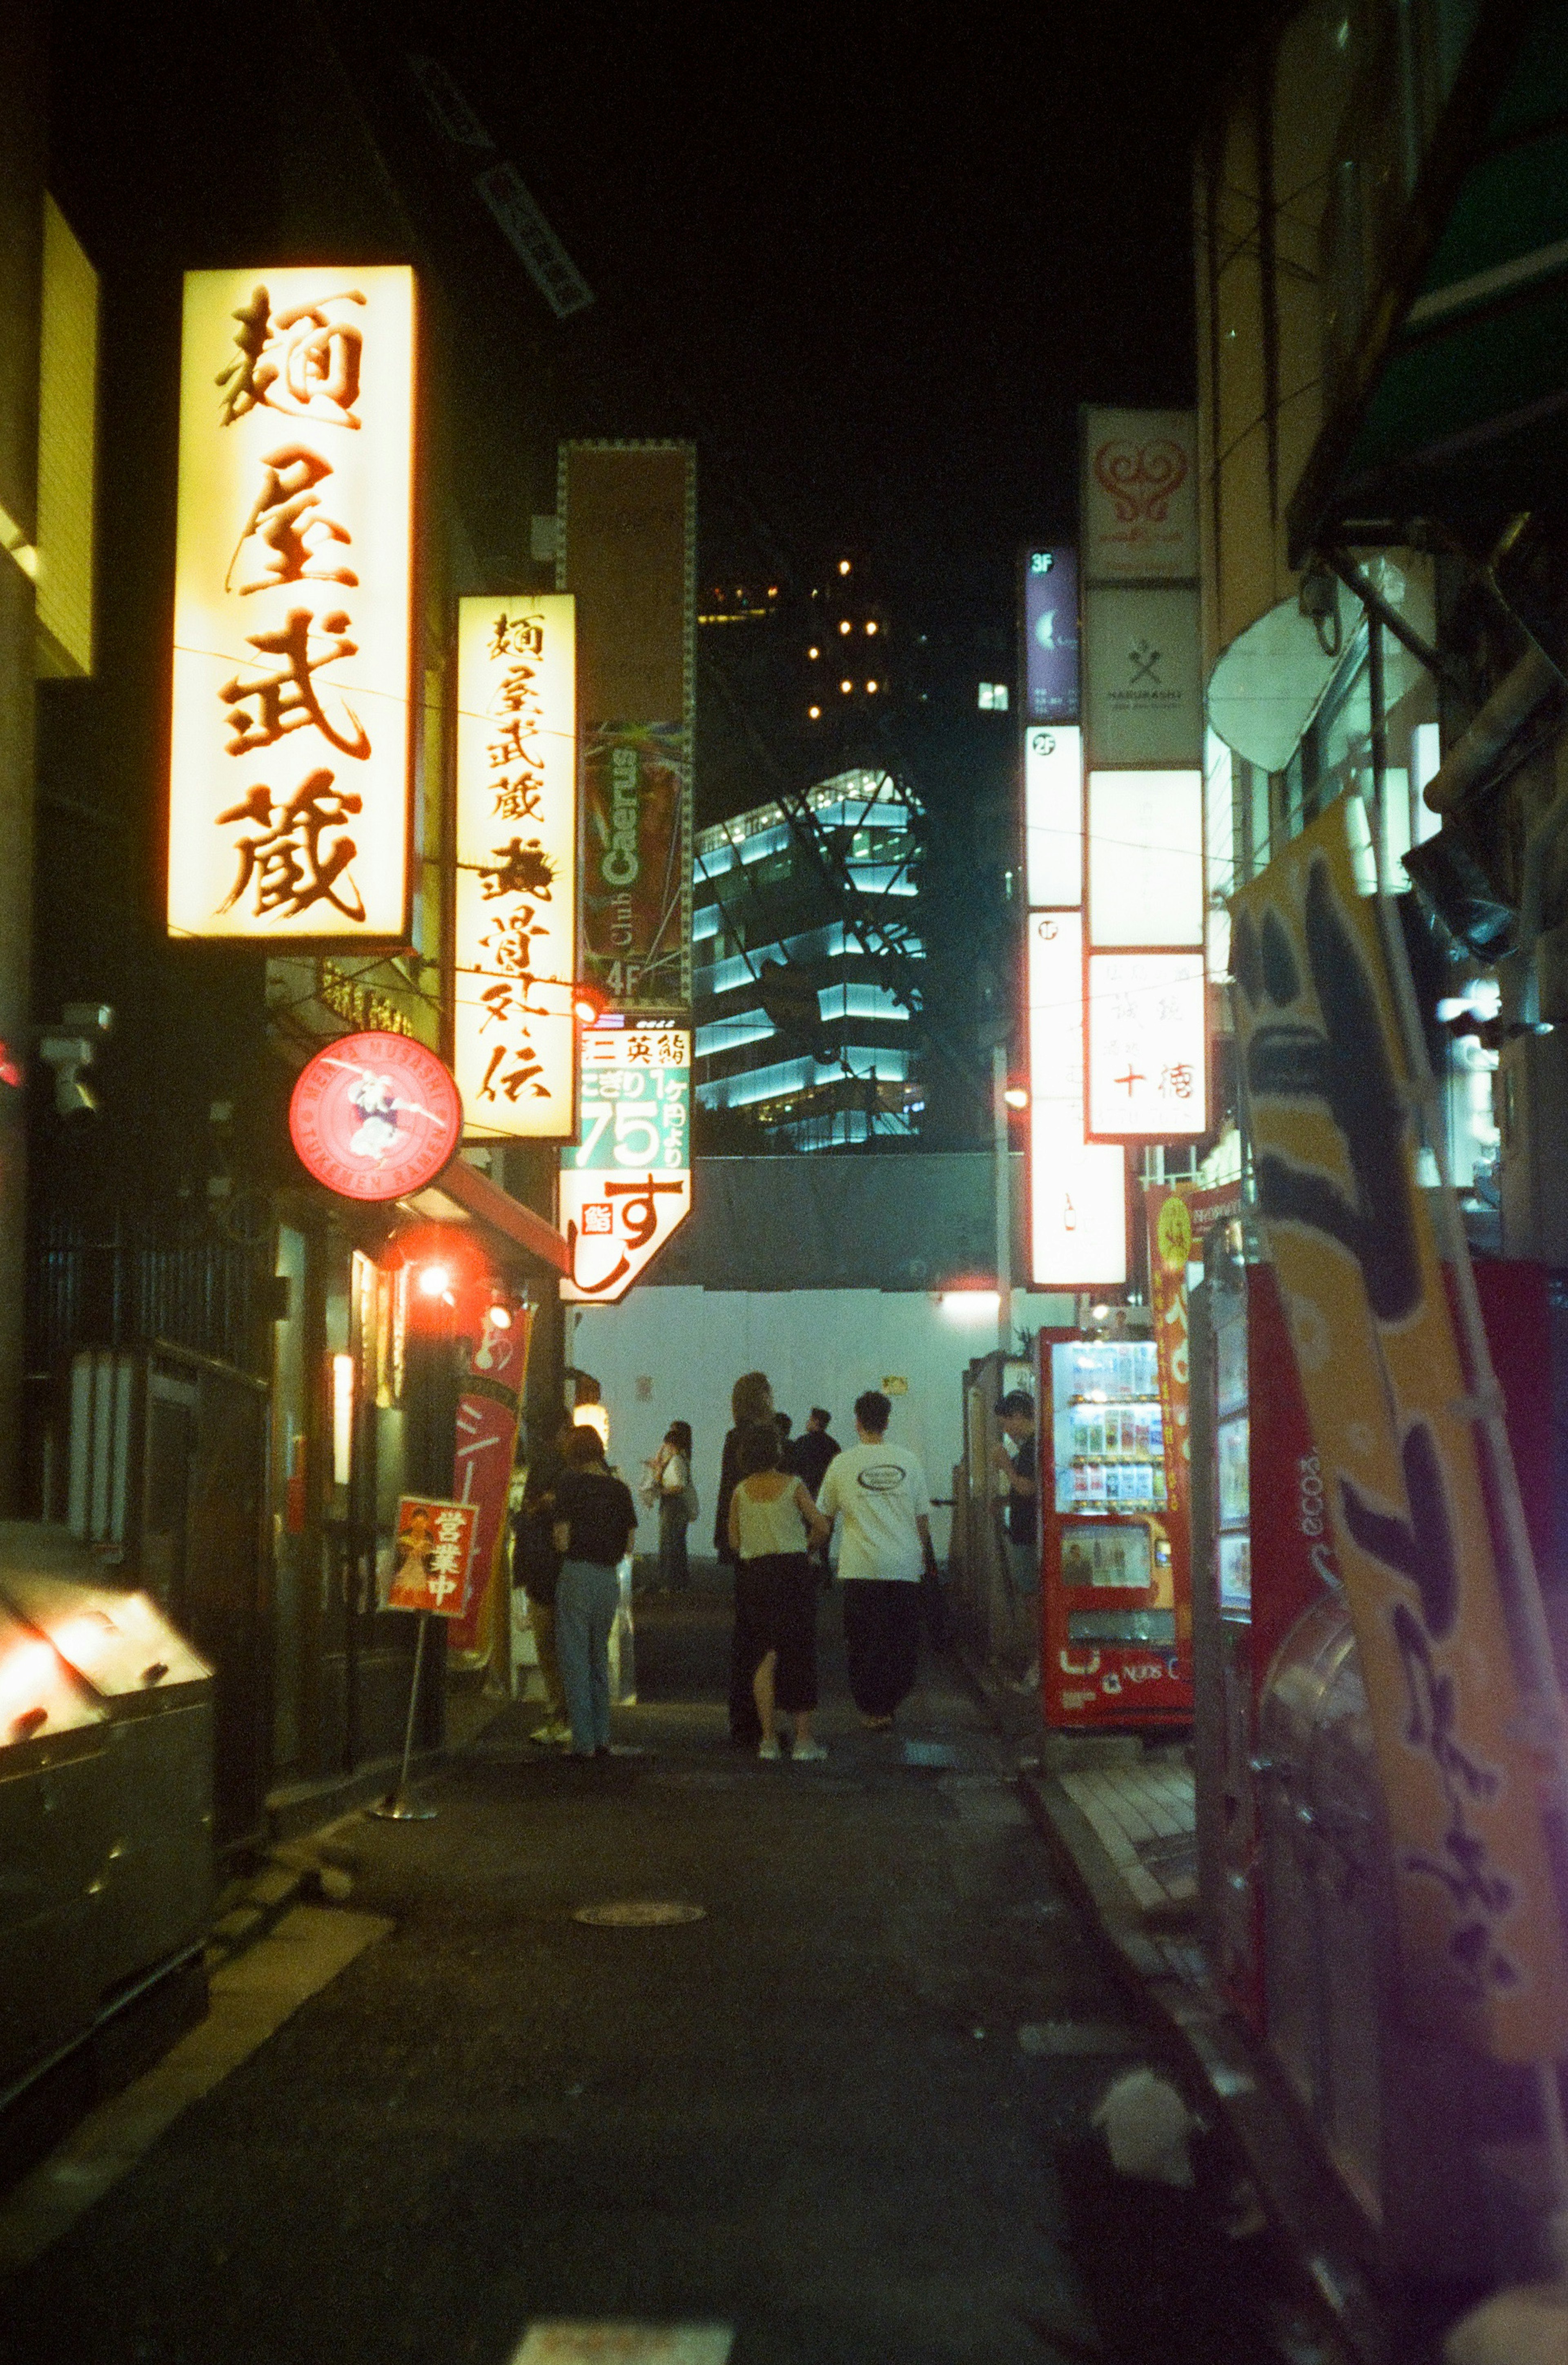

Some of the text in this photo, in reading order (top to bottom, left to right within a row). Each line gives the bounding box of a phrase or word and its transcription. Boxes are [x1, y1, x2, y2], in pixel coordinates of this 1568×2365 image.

[1031, 552, 1052, 572] 3F
[212, 283, 372, 924] 麺屋武蔵
[1035, 736, 1054, 754] 2F
[602, 747, 639, 946] Club Caerus
[606, 960, 640, 997] 4F
[369, 1041, 446, 1100] MUSASHI
[568, 1173, 685, 1294] すし
[428, 1512, 467, 1606] 営業中
